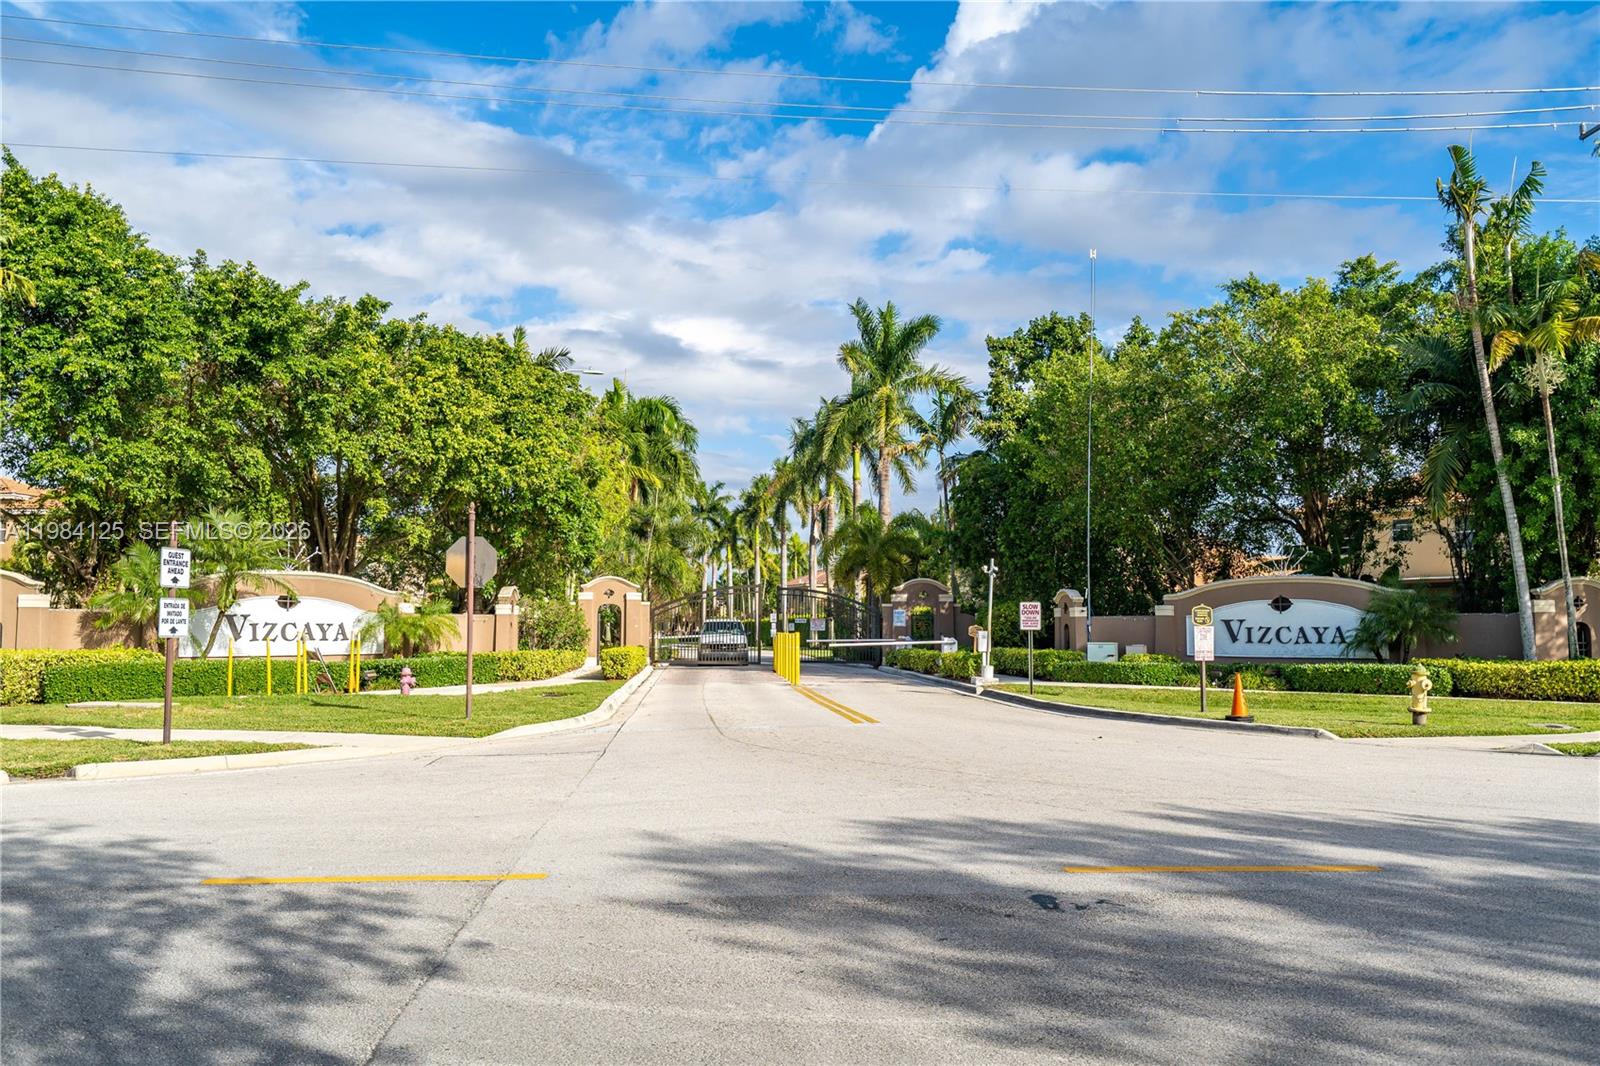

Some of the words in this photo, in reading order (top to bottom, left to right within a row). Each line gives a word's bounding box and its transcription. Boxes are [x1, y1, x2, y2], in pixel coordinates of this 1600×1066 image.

[163, 558, 188, 568] ENTRANCE
[168, 551, 184, 559] GUEST
[224, 613, 349, 643] VIZCAYA
[1221, 618, 1348, 645] VIZCAYA
